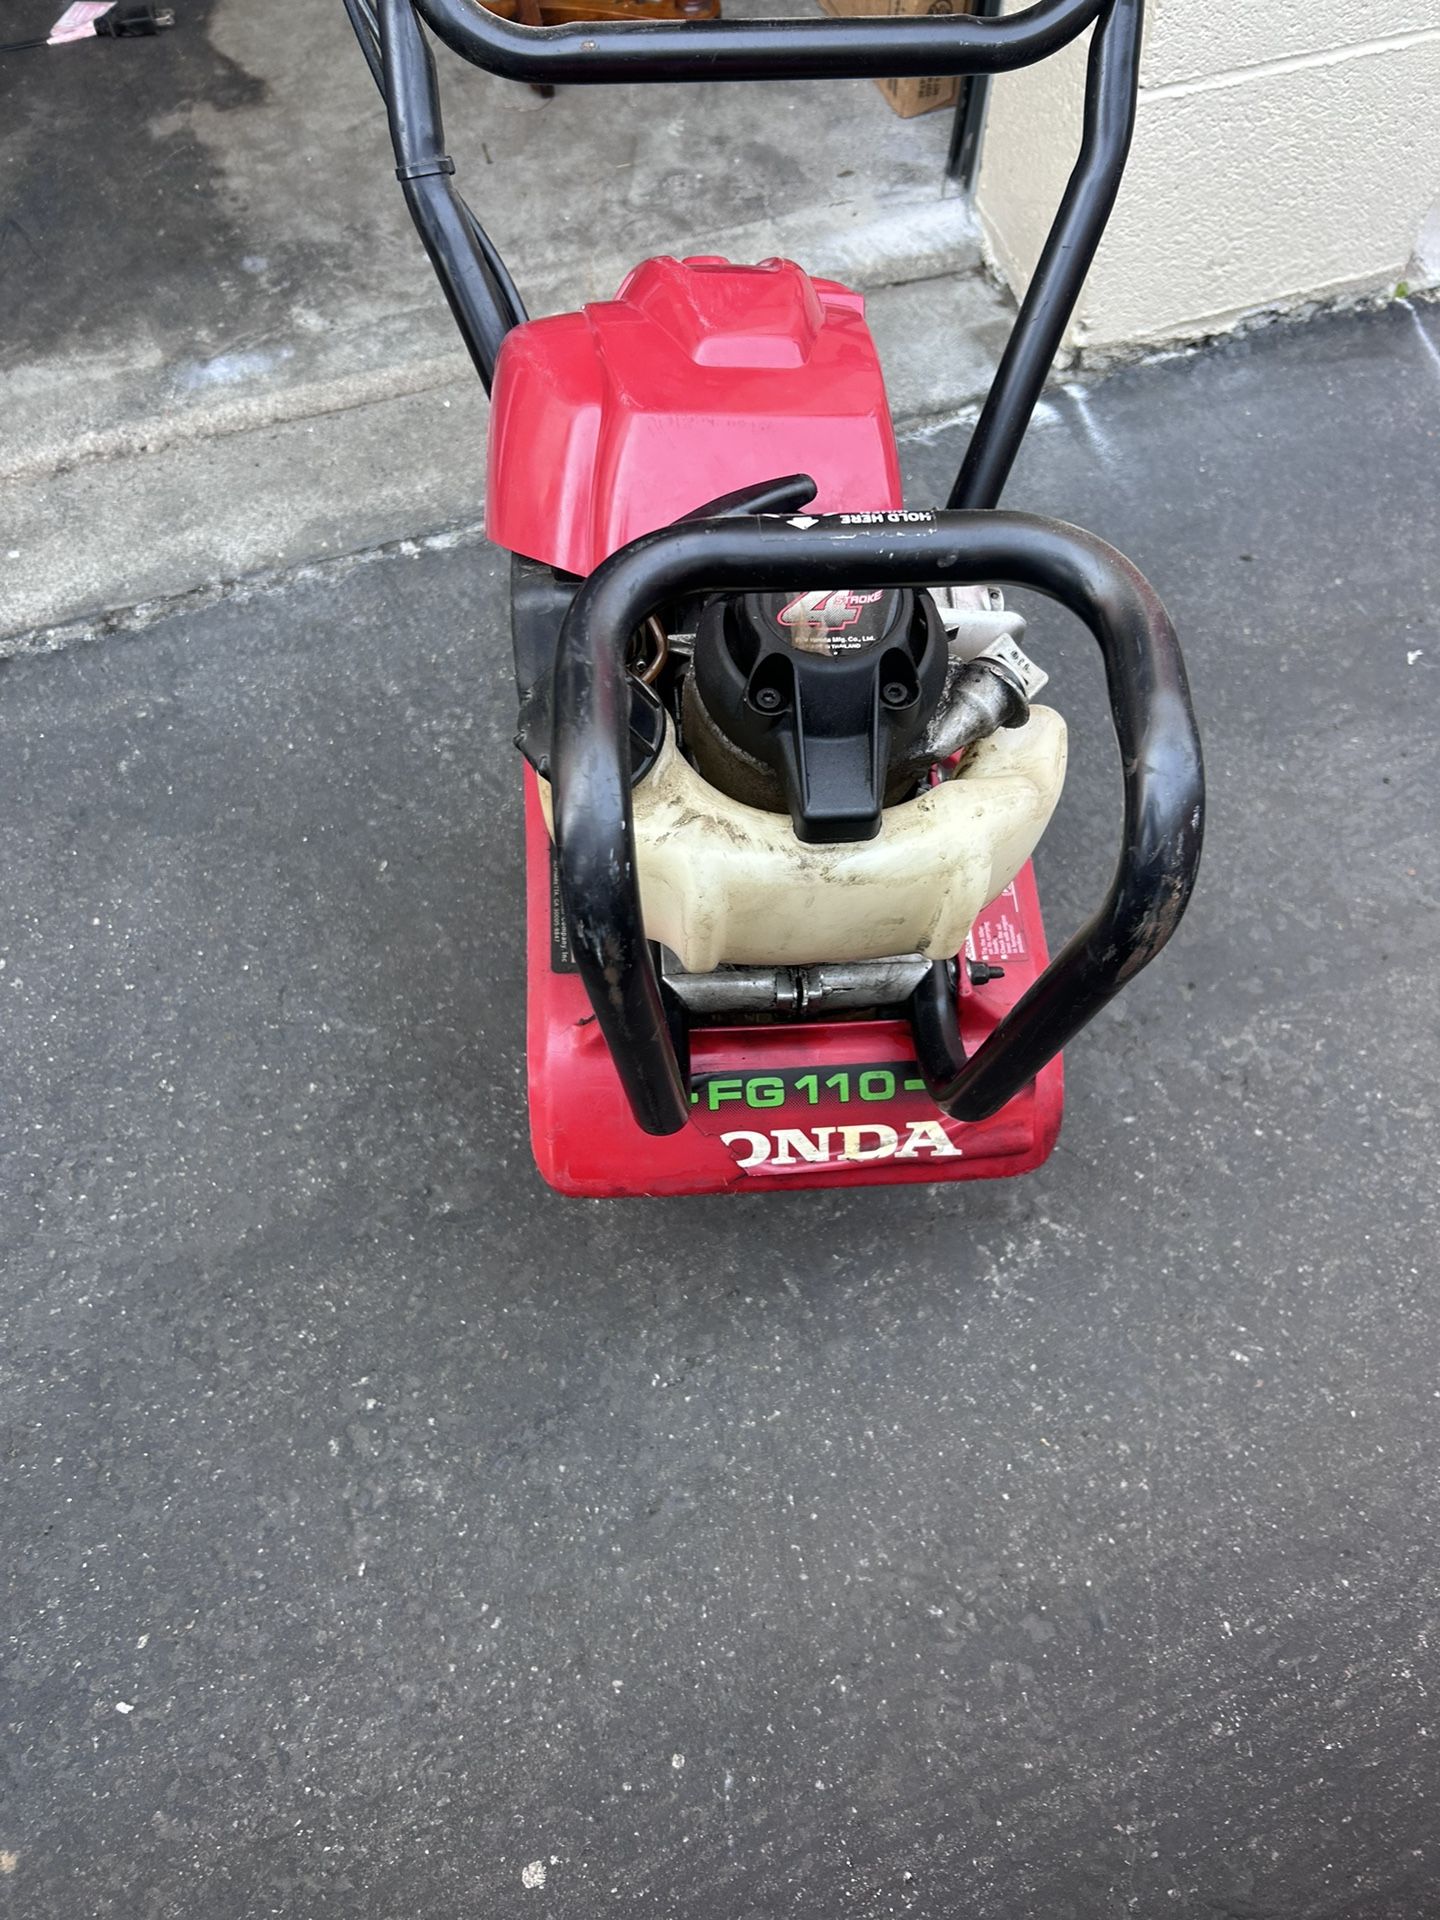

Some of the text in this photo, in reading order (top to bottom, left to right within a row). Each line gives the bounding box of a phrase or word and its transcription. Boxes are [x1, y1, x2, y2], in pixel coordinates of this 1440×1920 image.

[840, 512, 884, 524] HERE
[888, 512, 932, 522] HOLD
[776, 590, 883, 632] 4 STROKE
